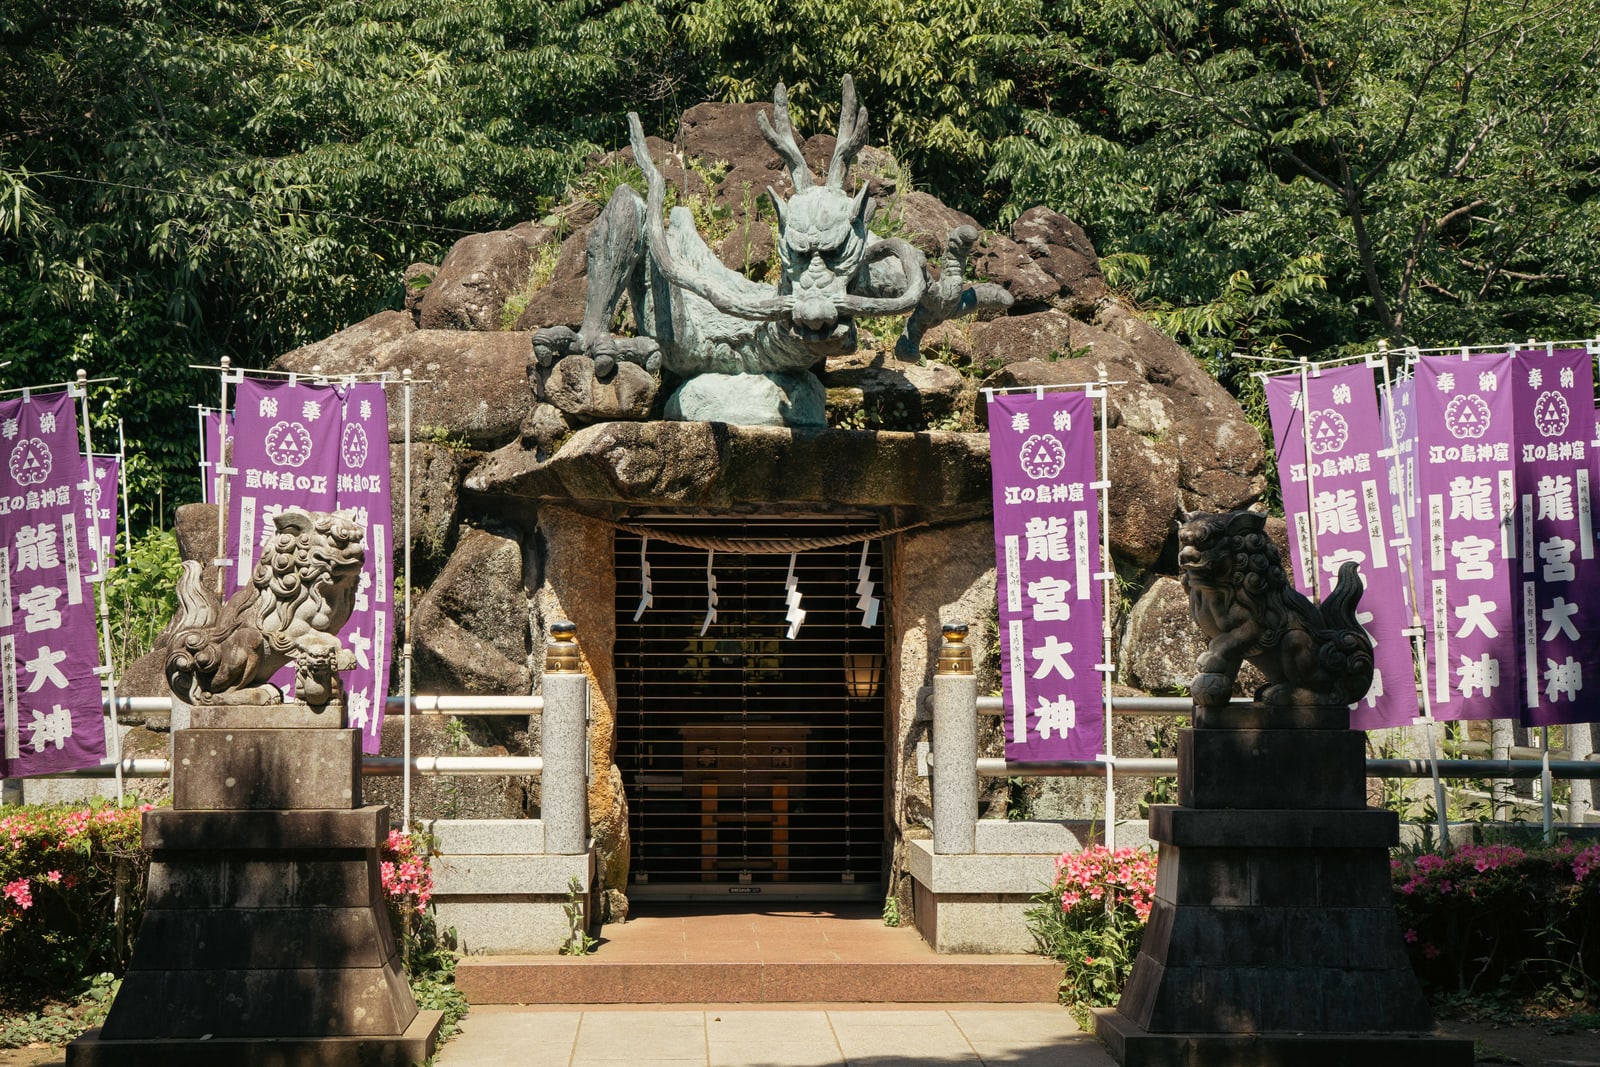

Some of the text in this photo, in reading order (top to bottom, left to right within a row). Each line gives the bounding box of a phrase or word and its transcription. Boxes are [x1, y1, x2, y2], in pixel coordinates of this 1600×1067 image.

[15, 522, 73, 753] 龍宮大神
[1025, 516, 1076, 740] 龍宮大神
[1449, 475, 1500, 699] 龍宮大神
[1536, 474, 1584, 704] 龍宮大神
